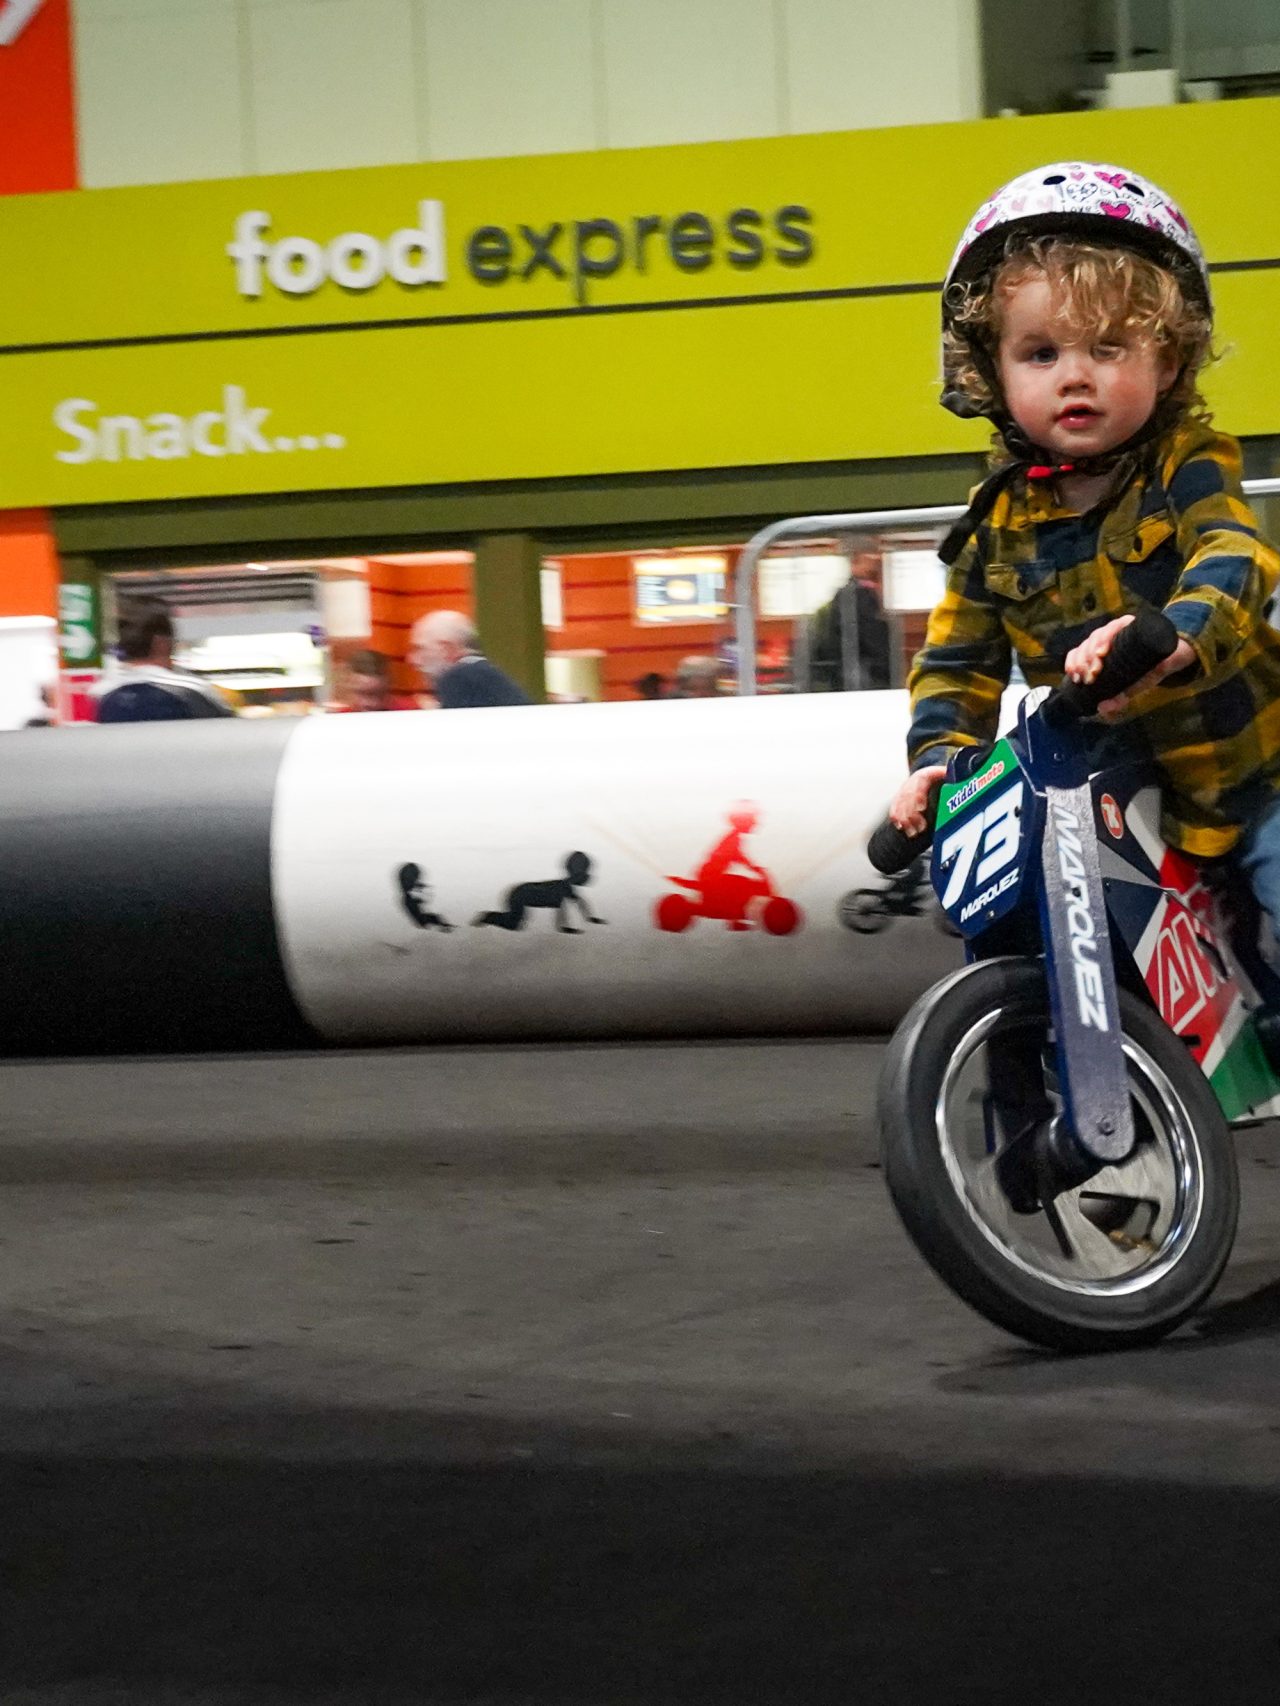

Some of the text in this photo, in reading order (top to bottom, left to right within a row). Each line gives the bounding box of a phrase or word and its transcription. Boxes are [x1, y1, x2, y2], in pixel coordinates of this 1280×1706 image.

[229, 200, 817, 306] food express
[54, 385, 347, 465] Snack...
[941, 781, 1023, 911] 73
[960, 868, 1020, 923] MARQUEZ
[1053, 805, 1109, 1032] MARQUEZ
